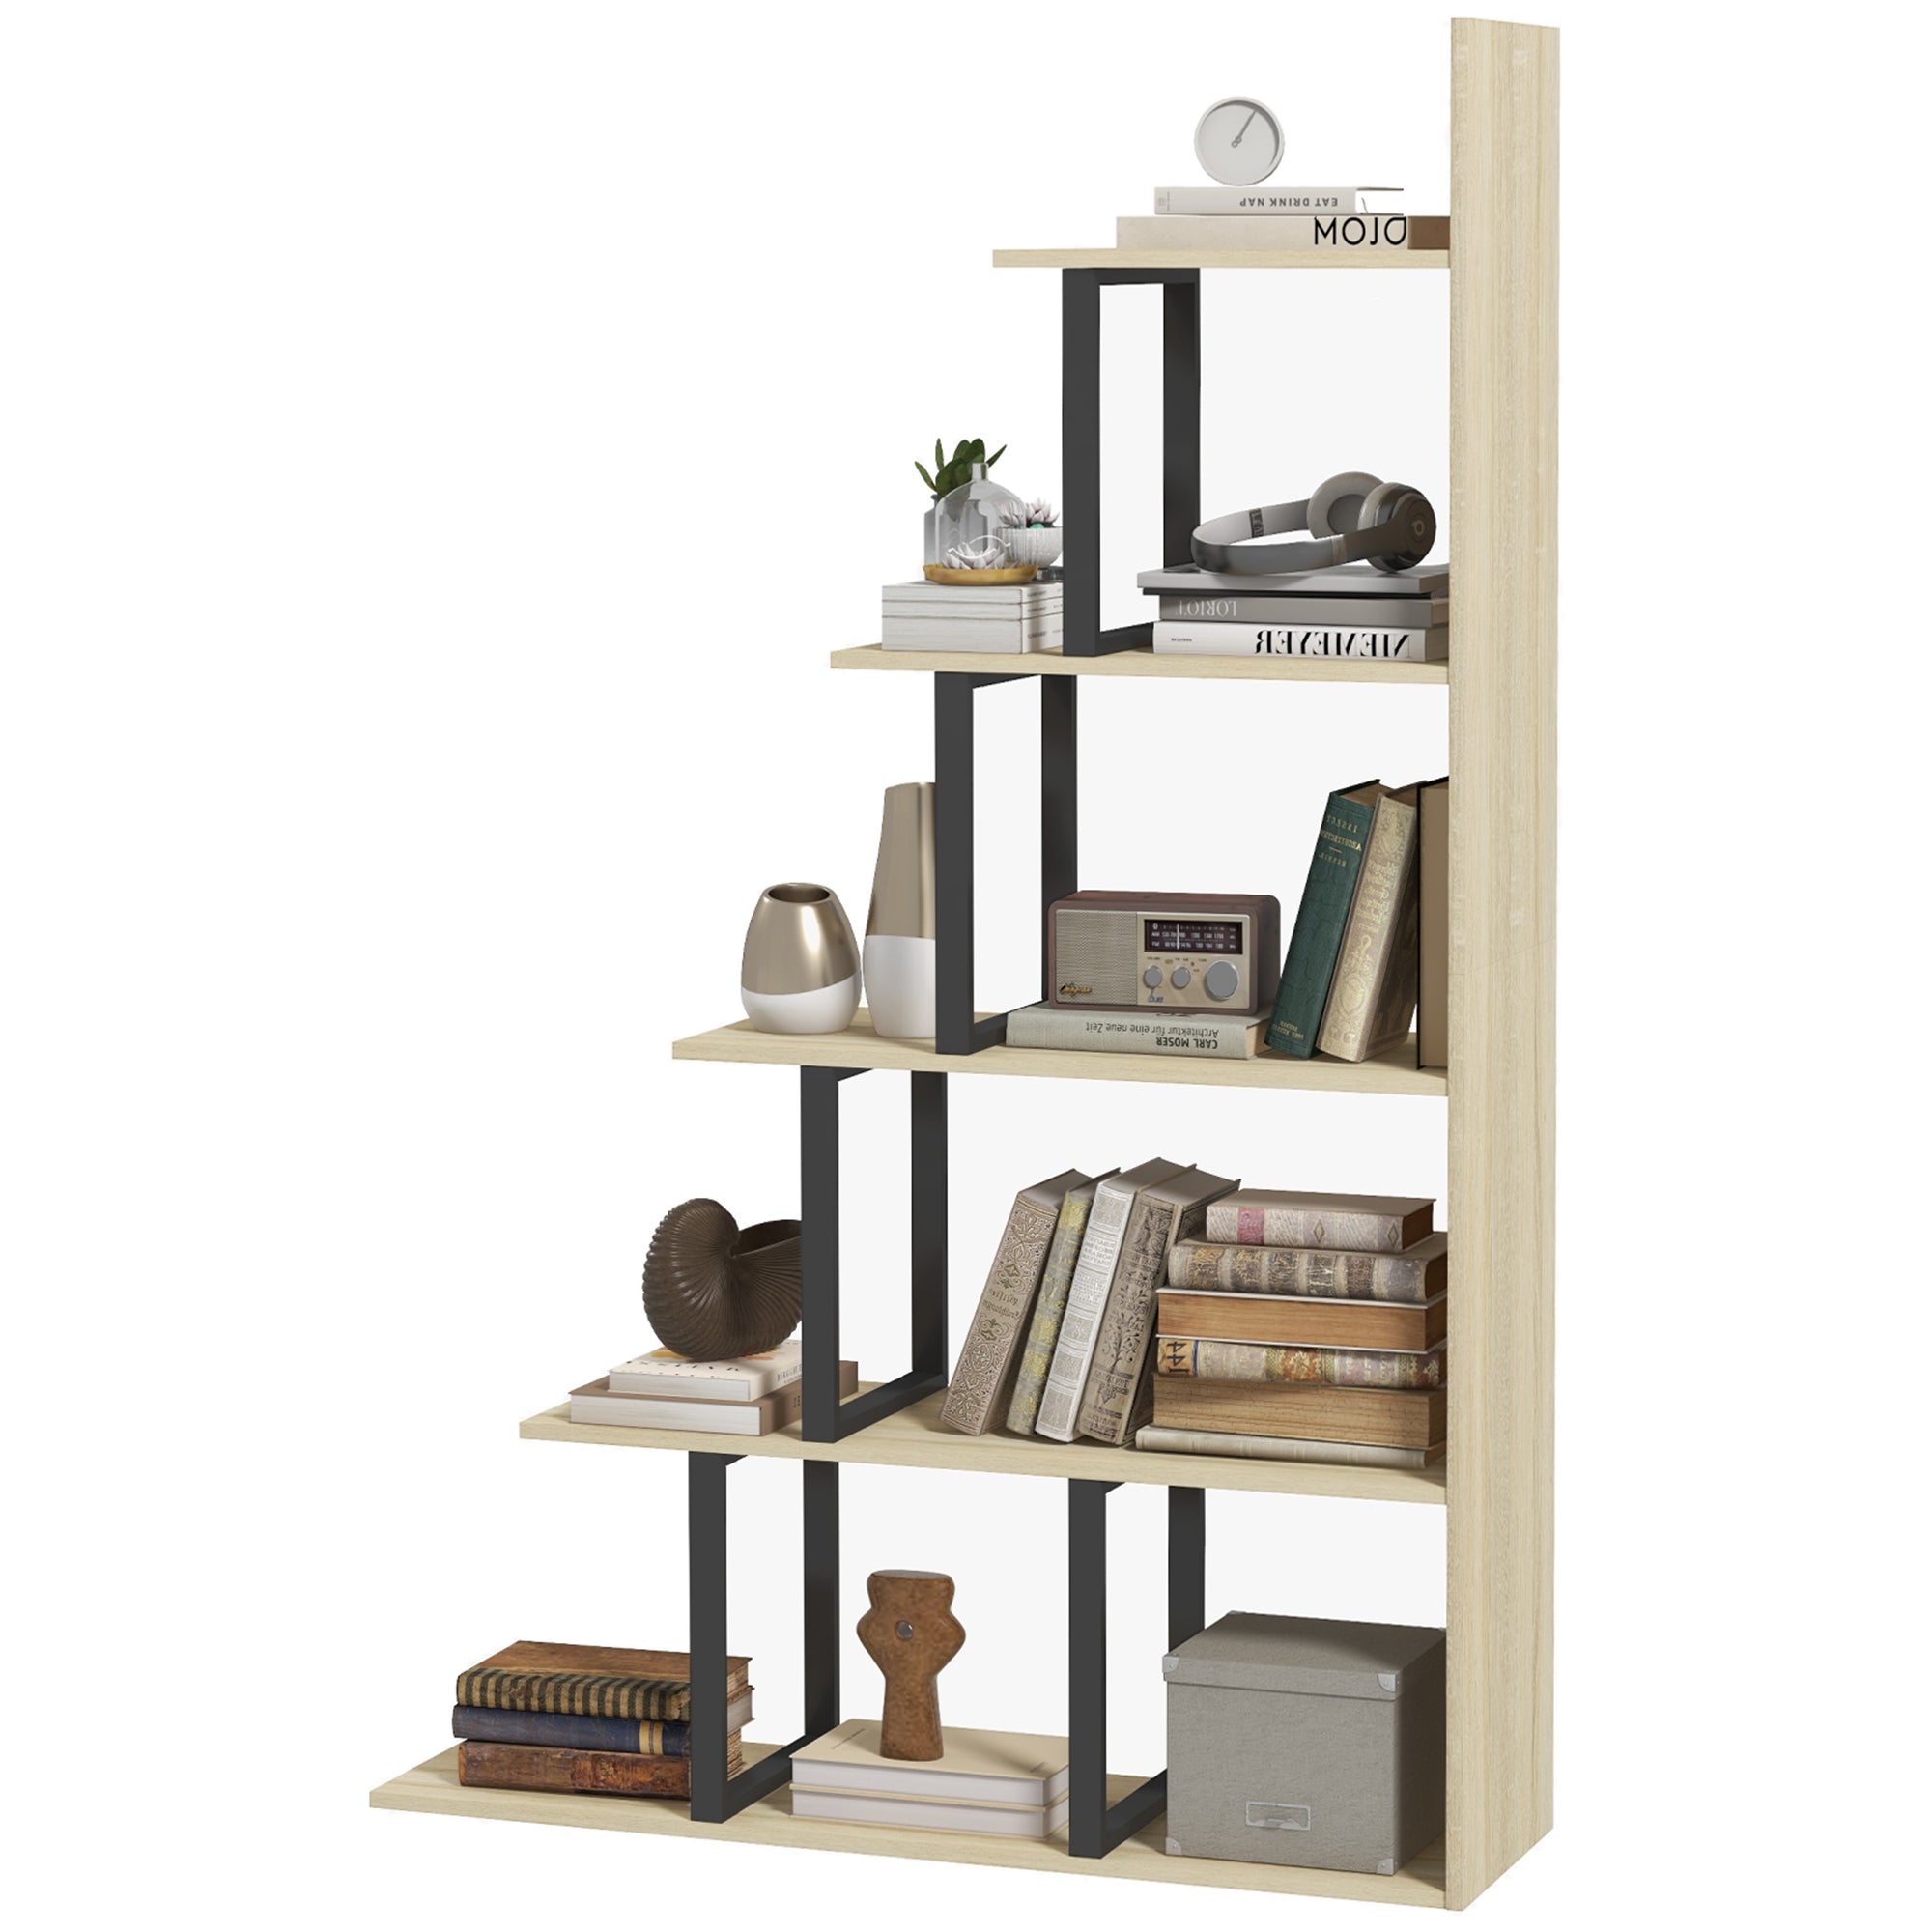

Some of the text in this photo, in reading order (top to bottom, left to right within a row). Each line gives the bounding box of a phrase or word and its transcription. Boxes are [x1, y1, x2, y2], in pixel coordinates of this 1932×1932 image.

[1239, 197, 1338, 207] EAT DRINK NAP
[1314, 216, 1406, 245] MOJO
[1175, 600, 1237, 617] LORIOT
[1086, 1022, 1219, 1038] Architektur für eine neue Zeit
[1155, 1037, 1218, 1050] CARL MOSER
